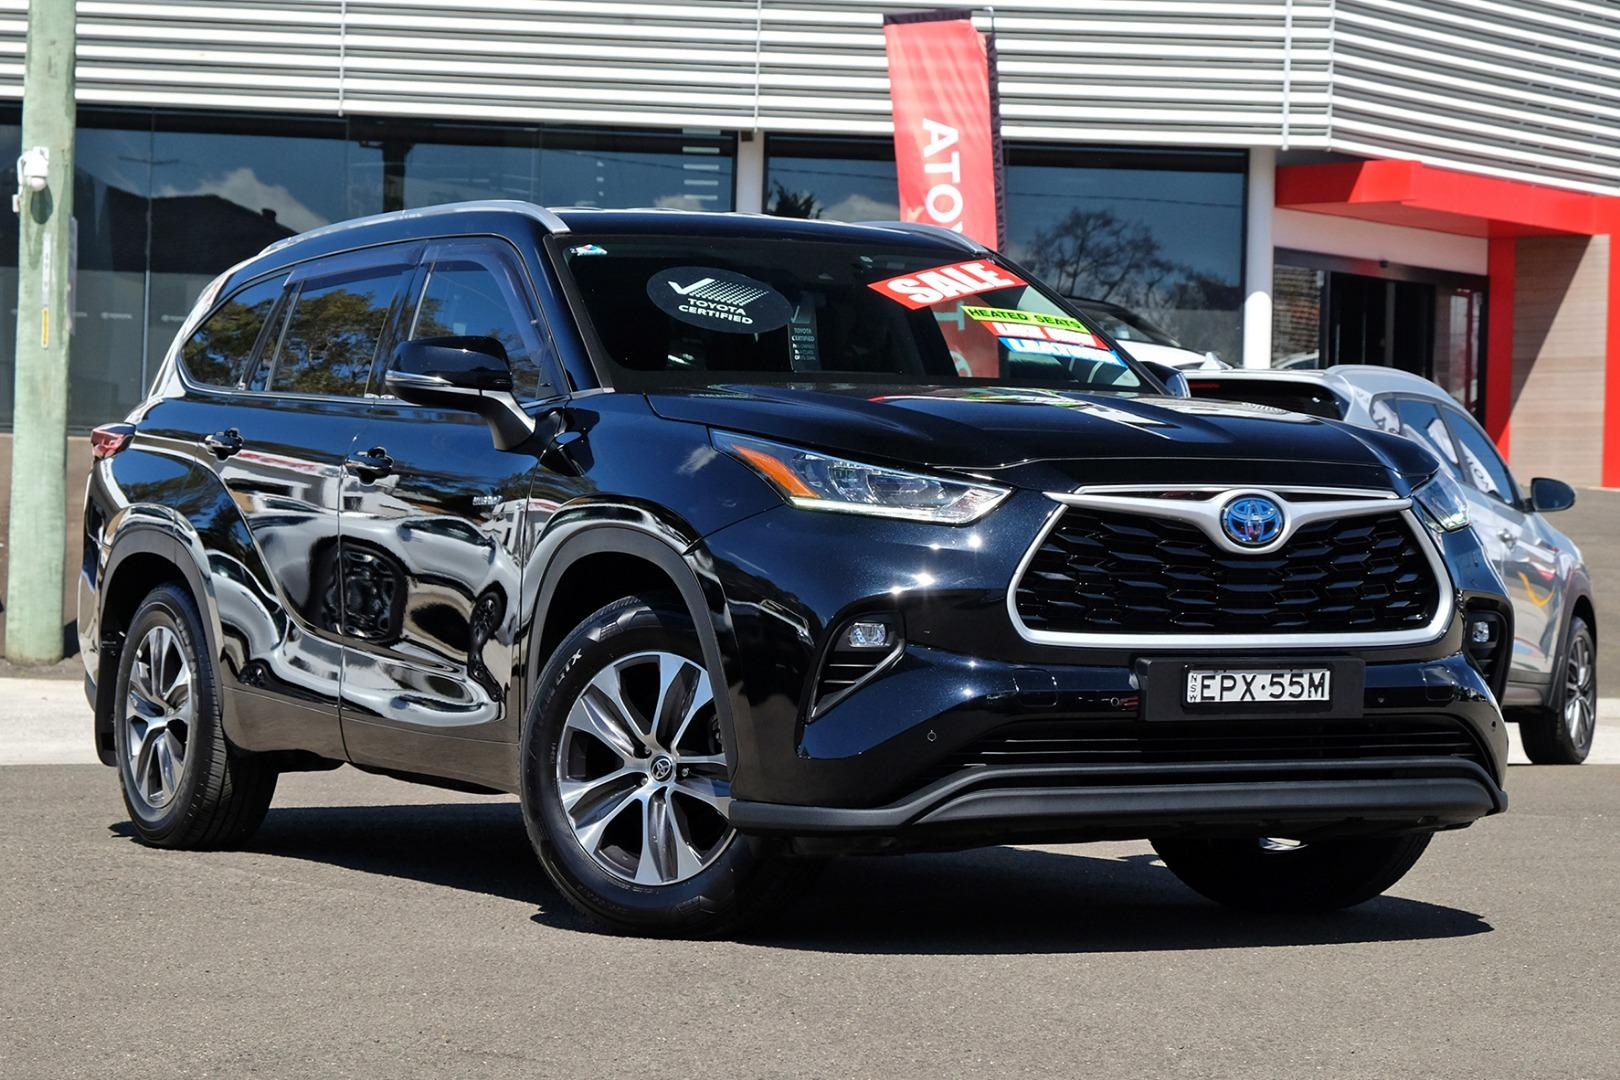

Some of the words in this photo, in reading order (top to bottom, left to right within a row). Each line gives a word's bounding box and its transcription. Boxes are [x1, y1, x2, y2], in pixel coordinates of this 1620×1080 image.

[887, 263, 1015, 304] SALE
[678, 305, 753, 325] CERTIFIED
[688, 298, 746, 315] TOYOTA
[967, 308, 1029, 321] HEATED
[1034, 315, 1081, 329] SEATS
